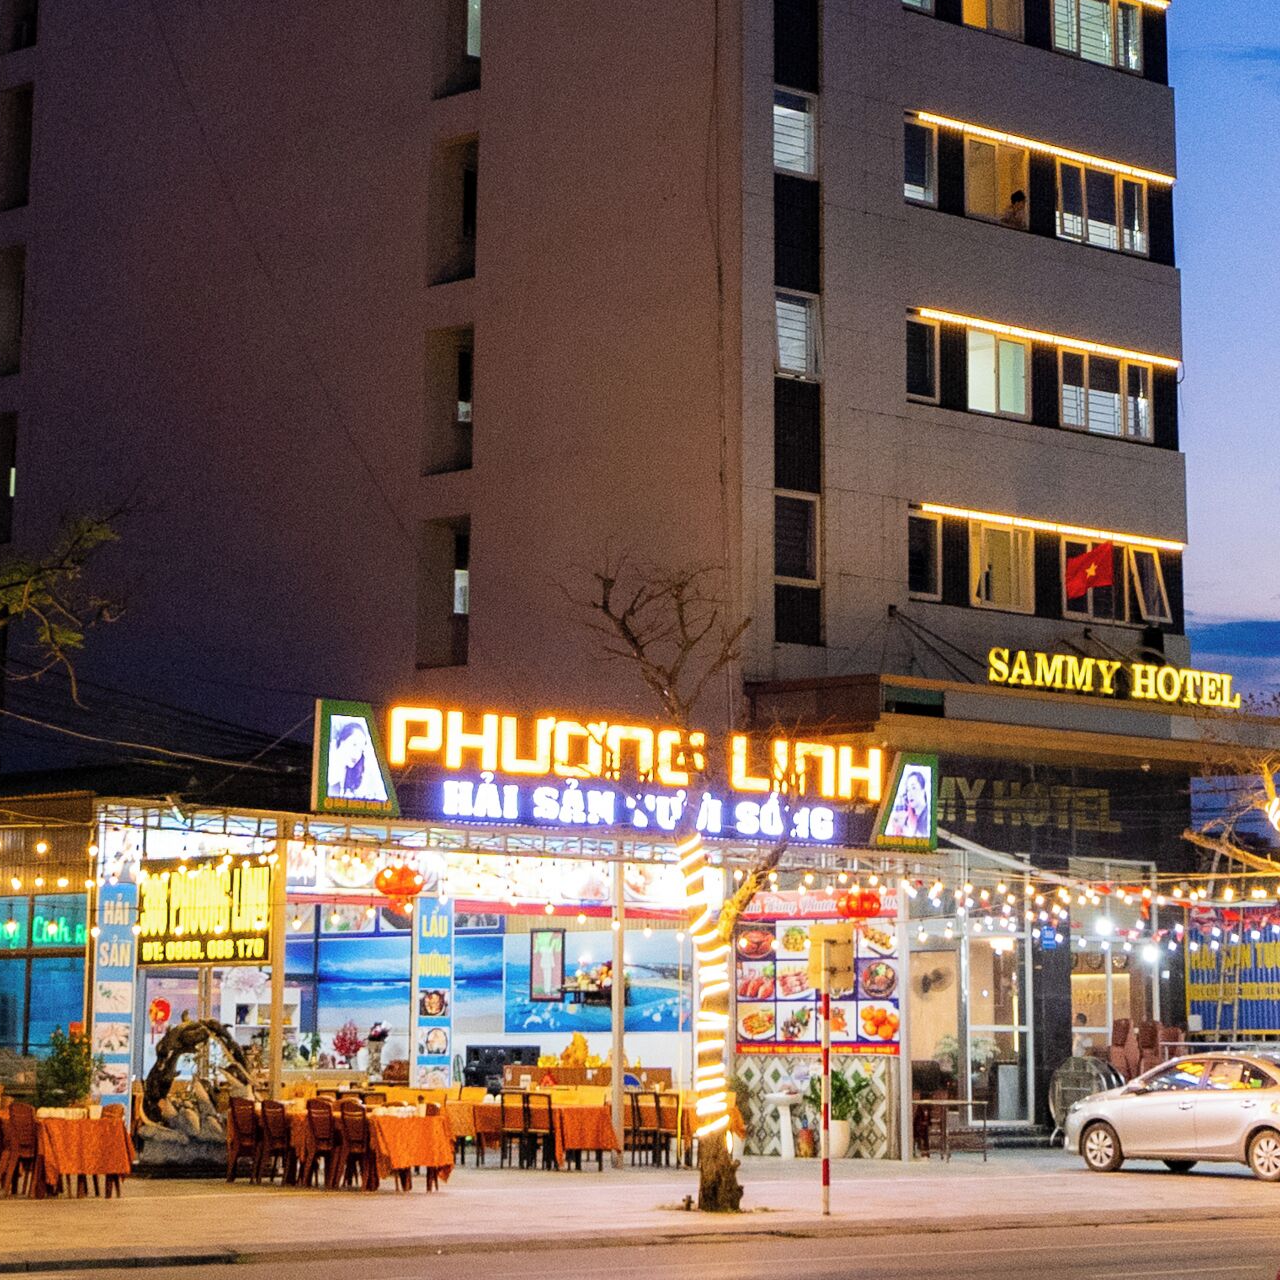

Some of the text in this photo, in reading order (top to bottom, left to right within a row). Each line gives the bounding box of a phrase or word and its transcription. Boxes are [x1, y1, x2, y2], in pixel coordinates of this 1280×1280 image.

[988, 646, 1241, 709] SAMMY HOTEL
[442, 771, 519, 820] HẢI
[532, 778, 616, 826] SẢN
[992, 780, 1122, 833] HOTEL
[104, 893, 130, 925] HẢI
[99, 934, 131, 967] SẢN
[235, 937, 265, 959] 170
